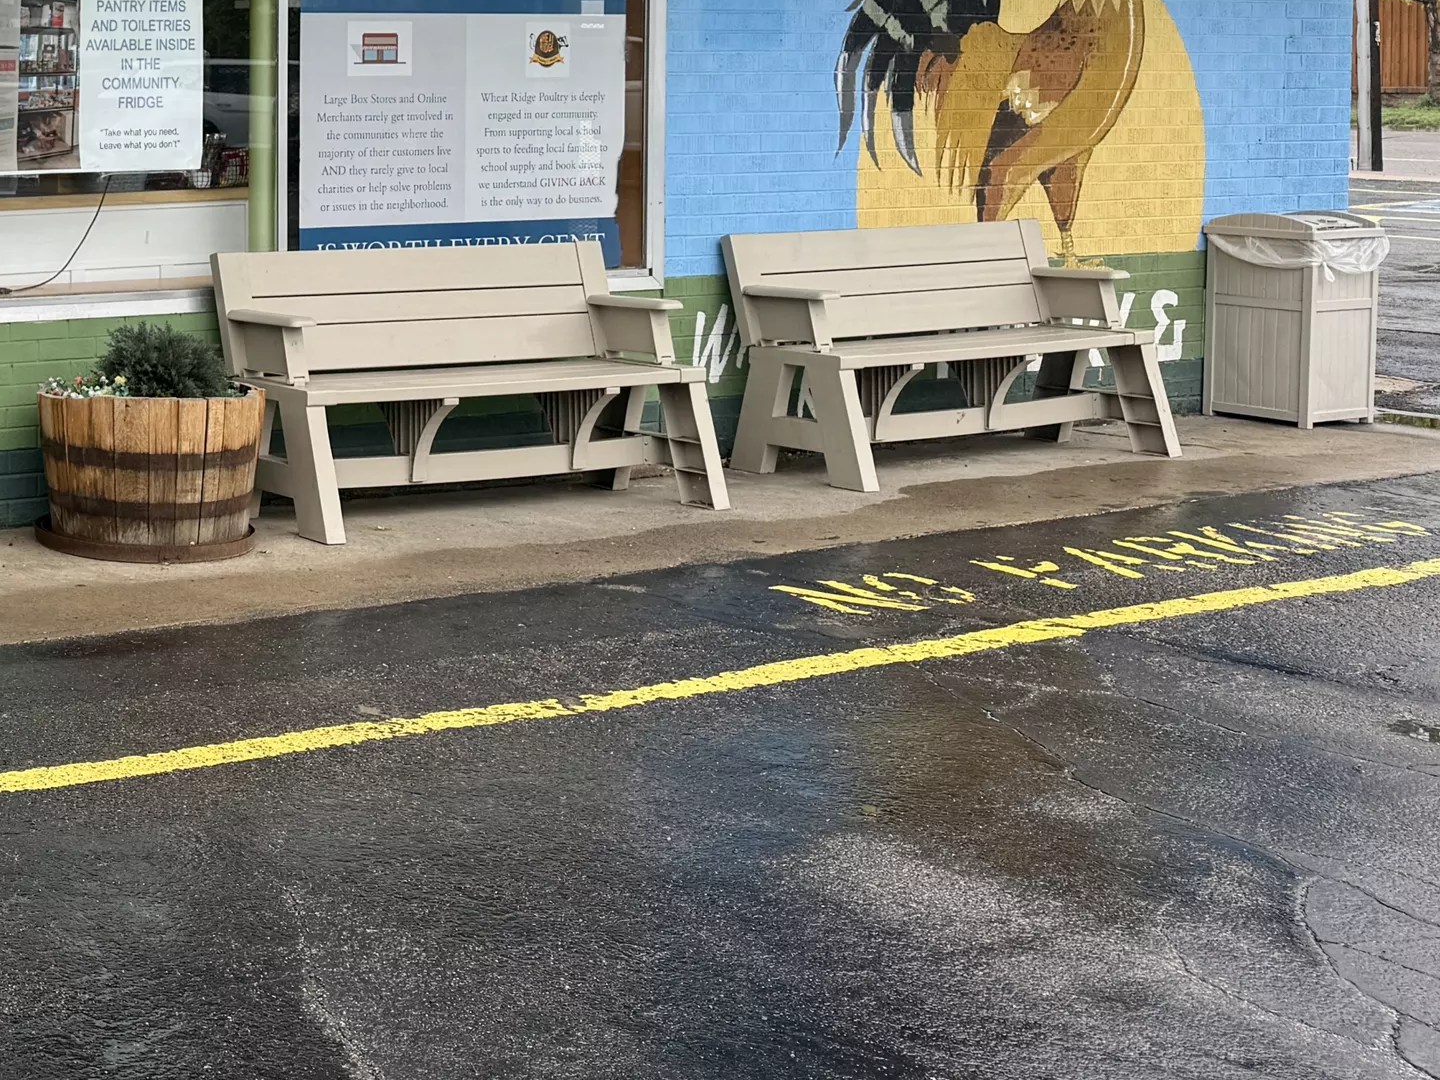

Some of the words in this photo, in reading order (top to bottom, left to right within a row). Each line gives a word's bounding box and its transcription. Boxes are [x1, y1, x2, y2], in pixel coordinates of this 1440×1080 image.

[97, 0, 146, 12] PANTRY
[149, 0, 186, 12] ITEMS
[91, 19, 118, 32] AND
[121, 19, 191, 32] TOILETRIES
[85, 38, 152, 51] AVAILABLE
[156, 38, 195, 51] INSIDE
[121, 58, 133, 71] IN
[136, 57, 161, 70] THE
[102, 76, 179, 90] COMMUNITY
[118, 96, 164, 109] FRIDGE
[324, 94, 348, 107] Large
[351, 94, 368, 104] Box
[370, 94, 397, 104] Stores
[399, 93, 415, 103] and
[417, 93, 447, 103] Online
[123, 128, 142, 136] what
[143, 129, 157, 138] you
[99, 142, 122, 150] Leave
[123, 141, 142, 149] what
[143, 142, 157, 151] you
